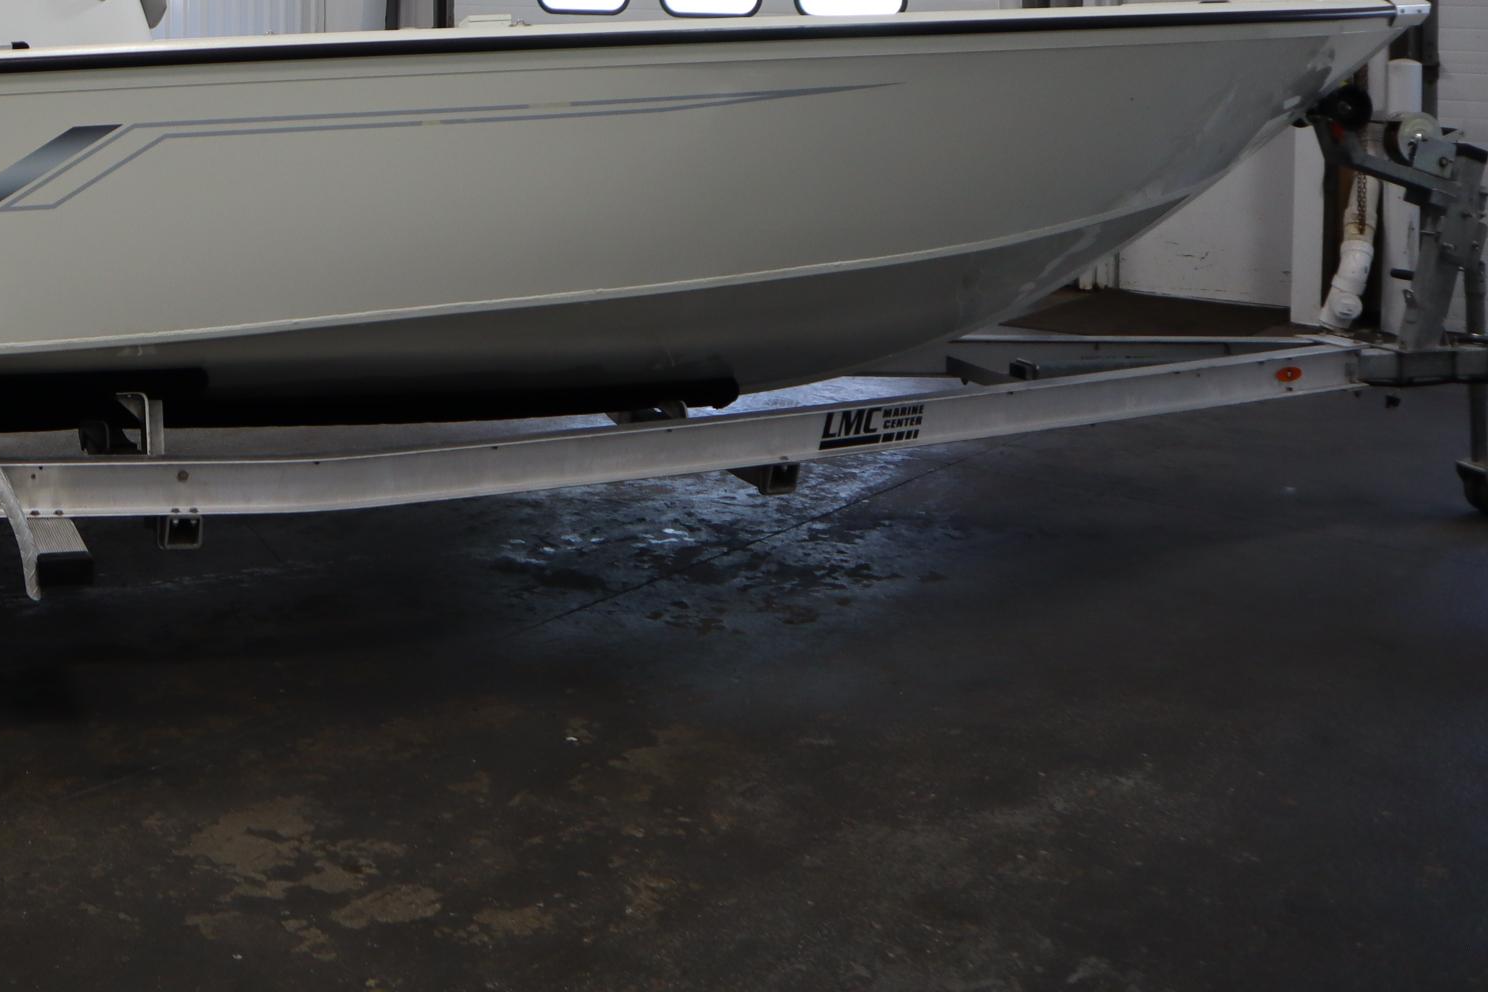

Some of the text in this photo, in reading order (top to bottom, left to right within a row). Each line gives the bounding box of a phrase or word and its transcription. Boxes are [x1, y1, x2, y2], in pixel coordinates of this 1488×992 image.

[822, 405, 924, 439] LMC MARINE
[883, 416, 923, 429] CENTER
